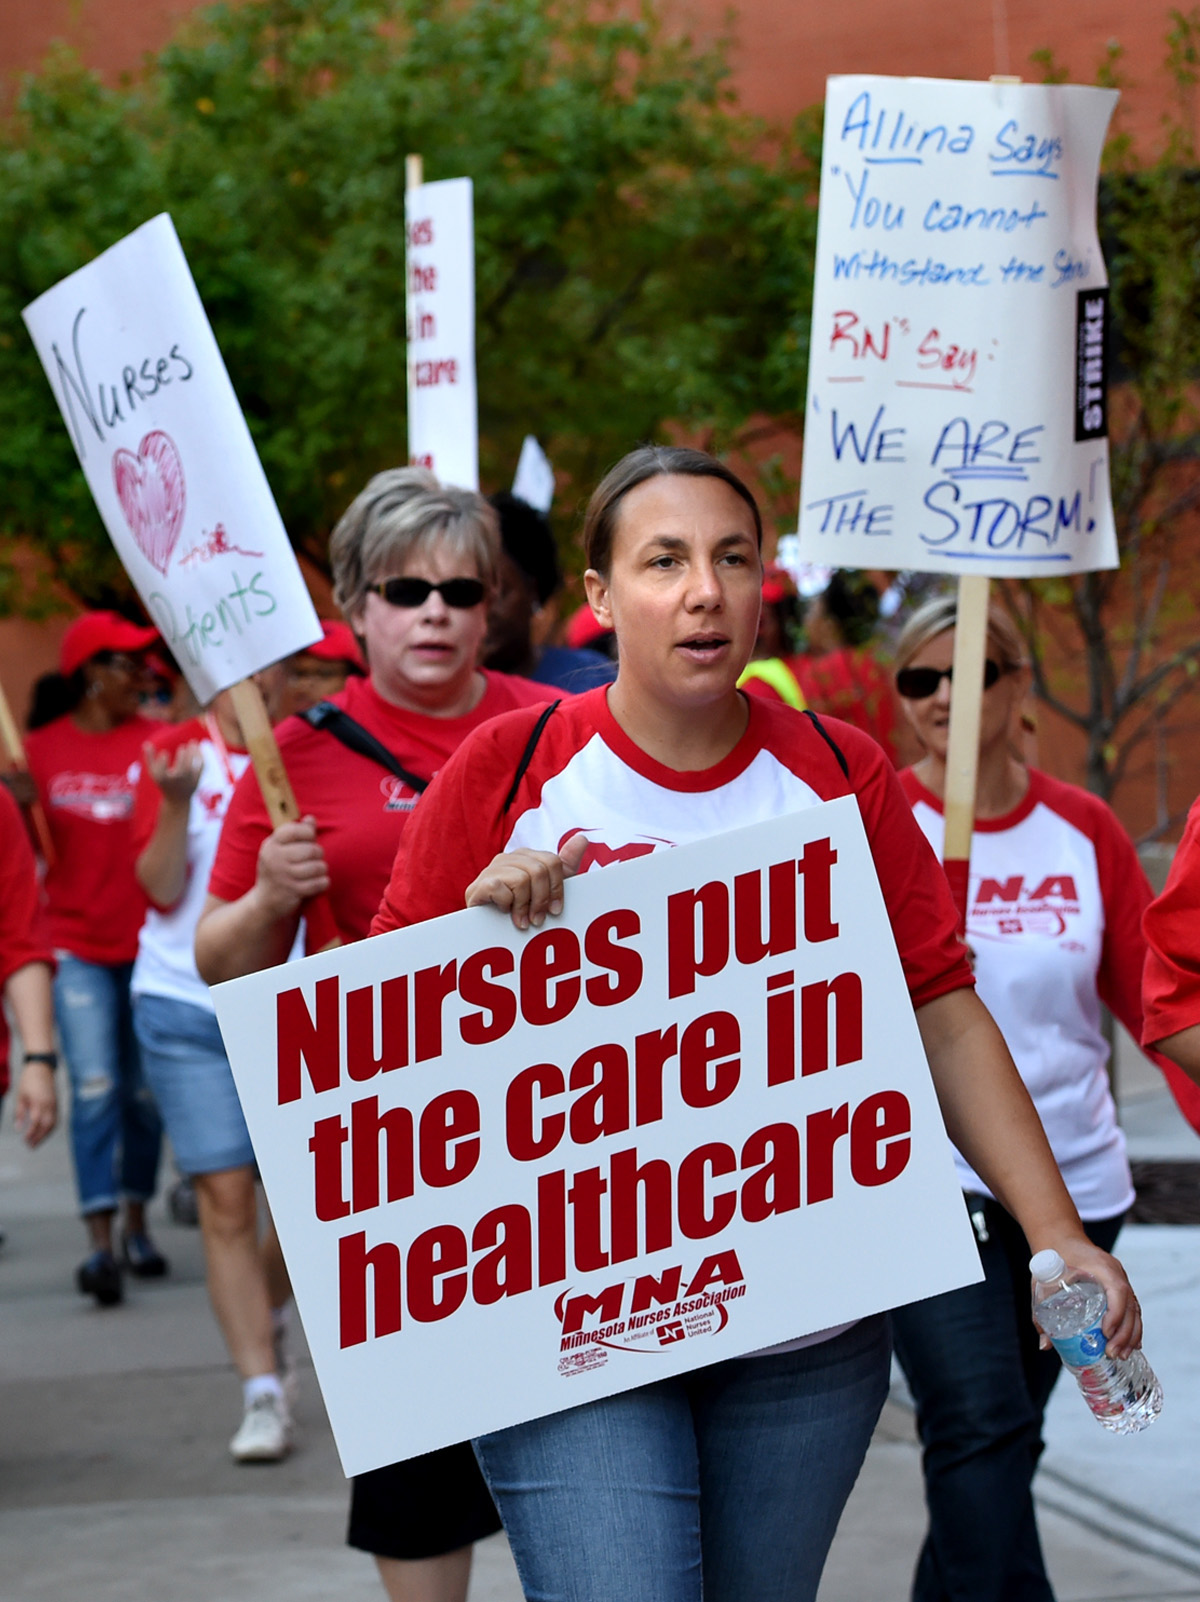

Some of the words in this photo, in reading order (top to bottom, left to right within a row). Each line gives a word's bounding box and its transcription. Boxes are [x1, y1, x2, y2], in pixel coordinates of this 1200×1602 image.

[841, 90, 975, 153] Allina
[923, 199, 1048, 233] cannot
[1000, 256, 1046, 284] the
[1083, 297, 1105, 431] STRIKE
[930, 416, 1045, 467] ARE
[806, 489, 895, 535] THE
[919, 457, 1104, 549] STORM!
[975, 875, 1079, 903] NA
[276, 909, 643, 1106] Nurses
[667, 837, 840, 1000] put
[309, 1089, 481, 1223] the
[505, 1011, 741, 1162] care
[766, 970, 863, 1087] in
[338, 1090, 912, 1350] healthcare
[560, 1322, 625, 1352] Minnesota
[628, 1307, 671, 1331] Nurses
[673, 1284, 747, 1317] Association
[562, 1249, 744, 1335] MNA
[684, 1309, 715, 1323] National
[686, 1319, 711, 1331] Nurses
[687, 1326, 712, 1338] United
